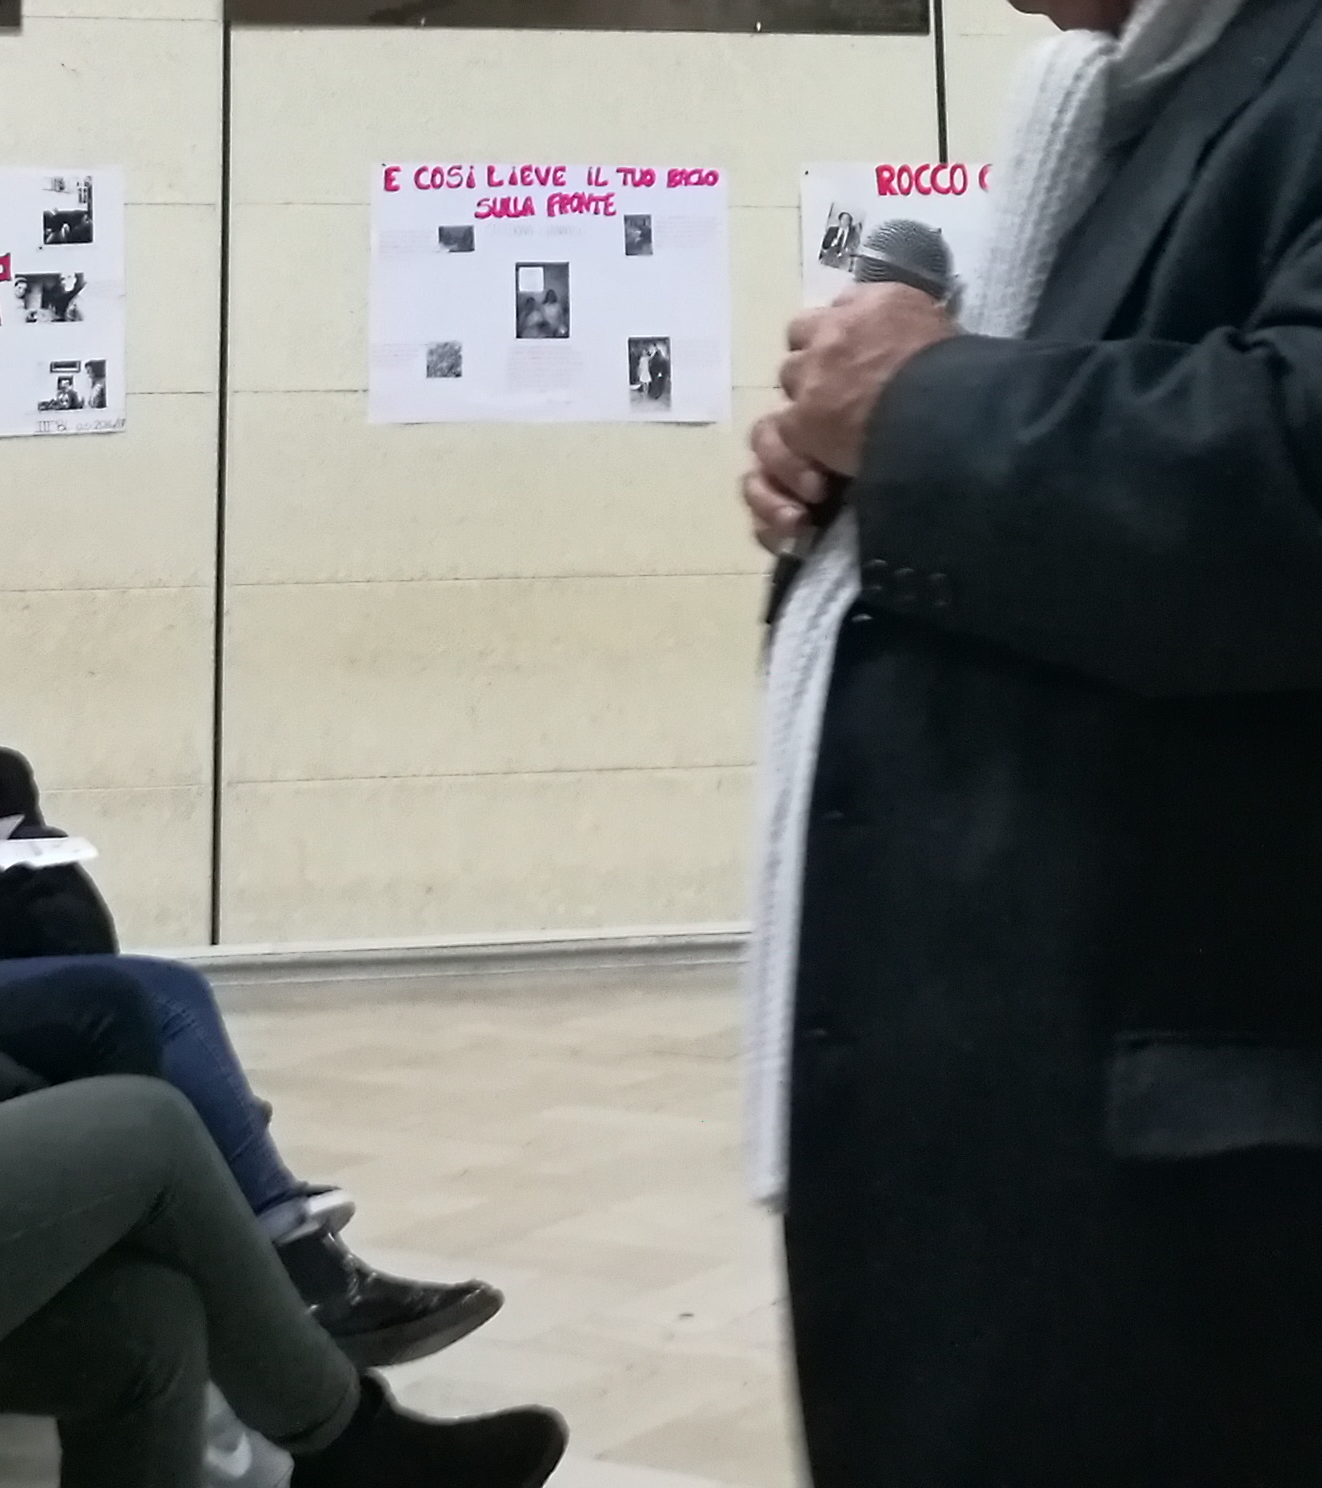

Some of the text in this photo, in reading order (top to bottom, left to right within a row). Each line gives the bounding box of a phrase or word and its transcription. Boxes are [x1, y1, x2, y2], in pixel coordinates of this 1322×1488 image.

[616, 167, 657, 188] TUO
[875, 163, 968, 197] ROCCO
[474, 191, 617, 220] SULLA FRONTE
